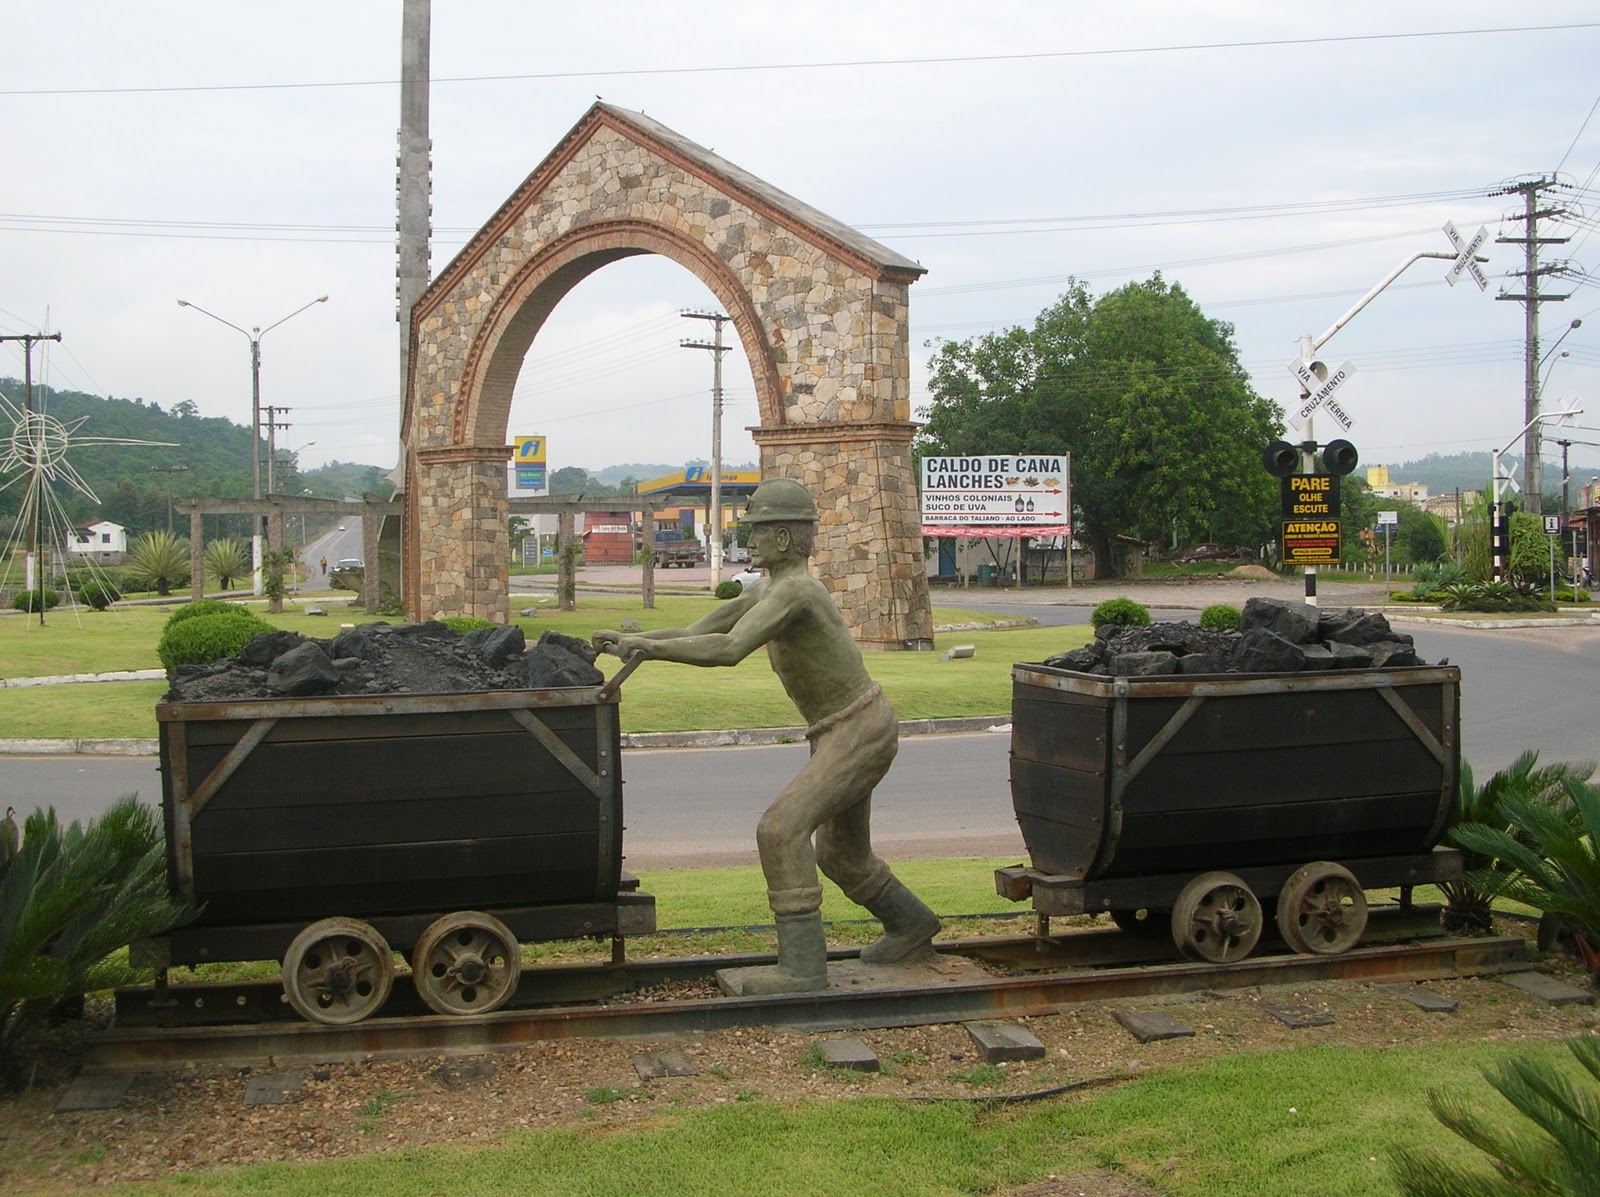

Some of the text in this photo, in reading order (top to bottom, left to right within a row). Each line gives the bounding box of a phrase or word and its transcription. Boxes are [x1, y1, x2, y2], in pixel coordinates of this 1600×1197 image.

[1449, 228, 1459, 243] VIA
[1453, 234, 1483, 275] CRUZAMENTO
[1297, 366, 1311, 383] VIA
[1300, 370, 1346, 419] CRUZAMENTO
[1326, 399, 1353, 430] FÉRREA
[927, 458, 1061, 473] CALDO DE CANA
[927, 474, 1004, 489] LANCHES
[1291, 477, 1330, 491] PARE
[925, 494, 1013, 502] VINHOS COLONIAIS
[1299, 493, 1323, 502] OLHE
[925, 503, 987, 511] SUCO DE UVA
[1293, 504, 1329, 514] ESCUTE
[1286, 522, 1337, 535] ATENÇÃO
